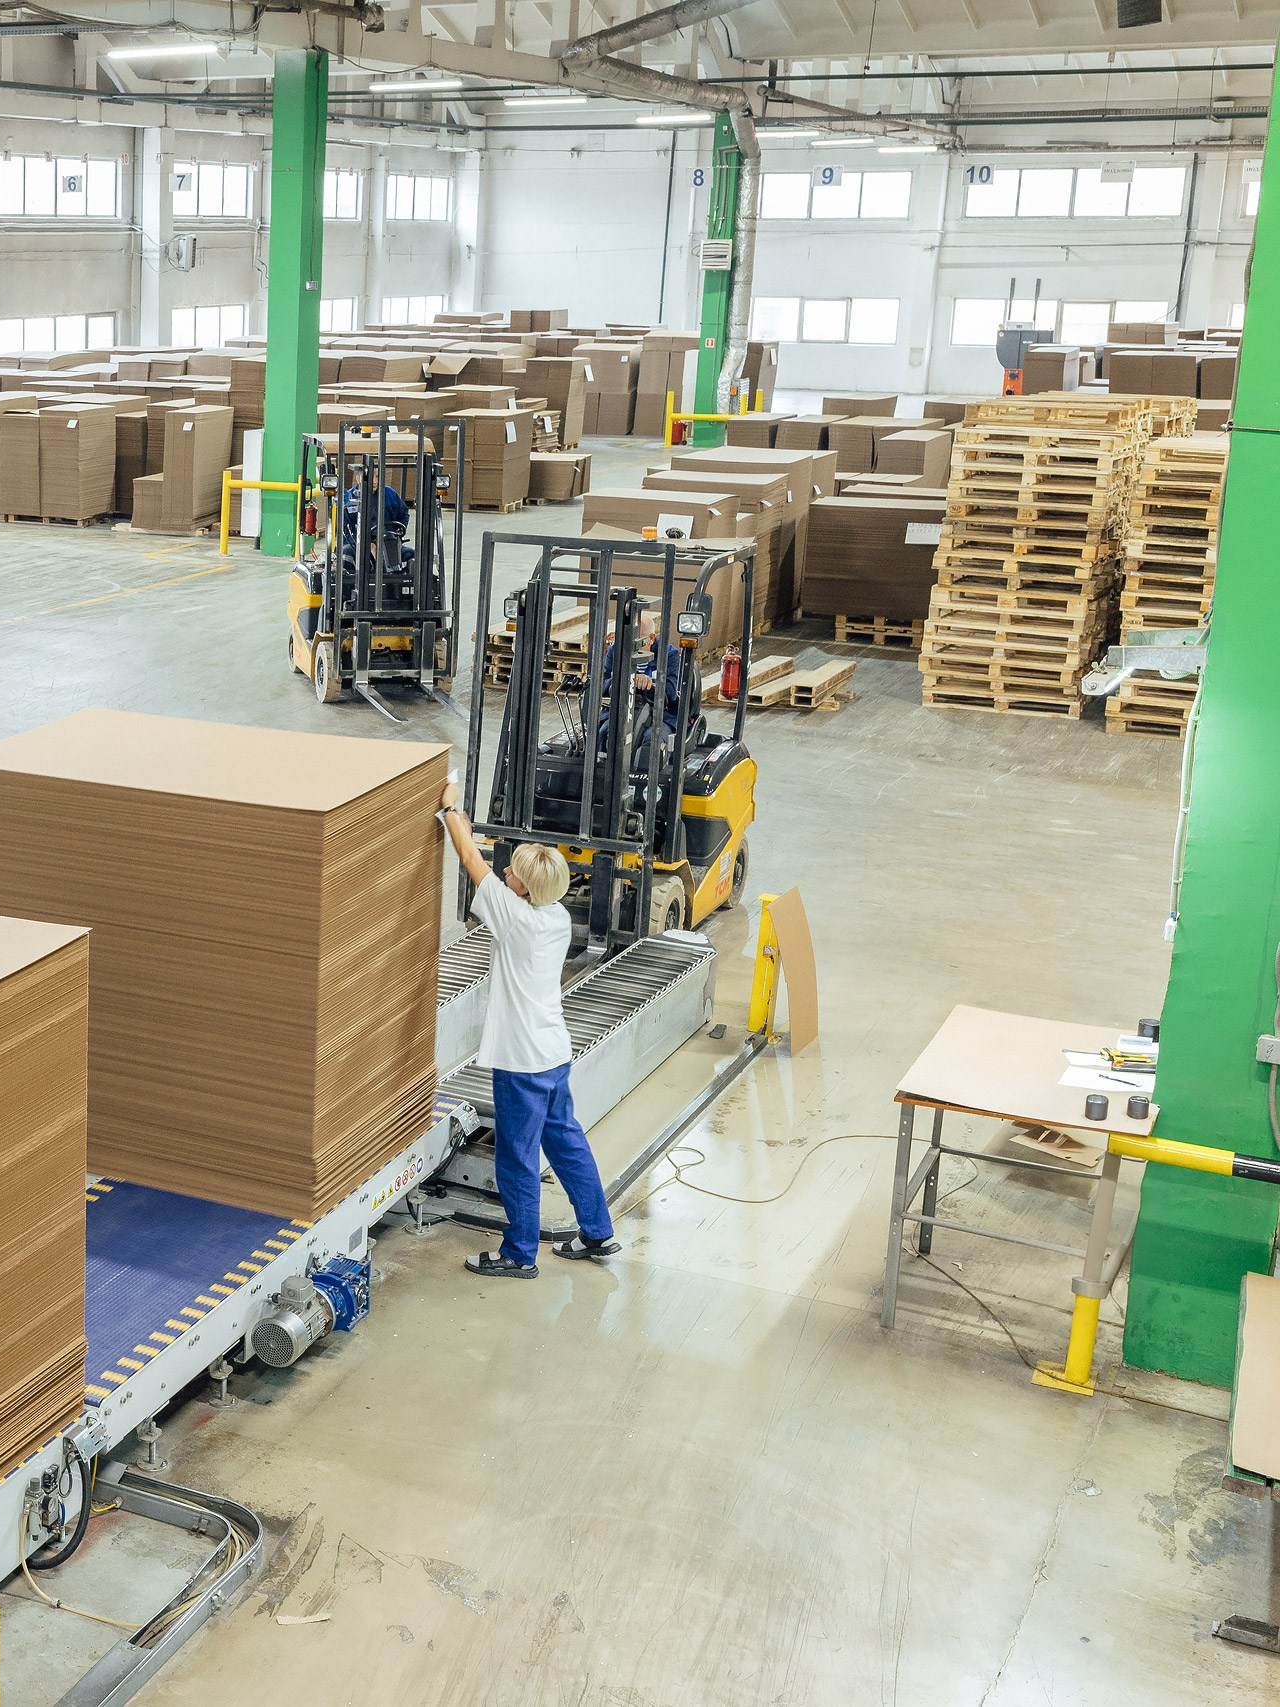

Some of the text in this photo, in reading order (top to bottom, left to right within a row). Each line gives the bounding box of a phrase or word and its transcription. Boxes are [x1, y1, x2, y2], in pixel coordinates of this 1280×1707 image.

[176, 174, 186, 190] 7
[693, 168, 704, 187] 8
[821, 167, 834, 185] 9
[966, 165, 991, 184] 10
[67, 176, 77, 192] 6
